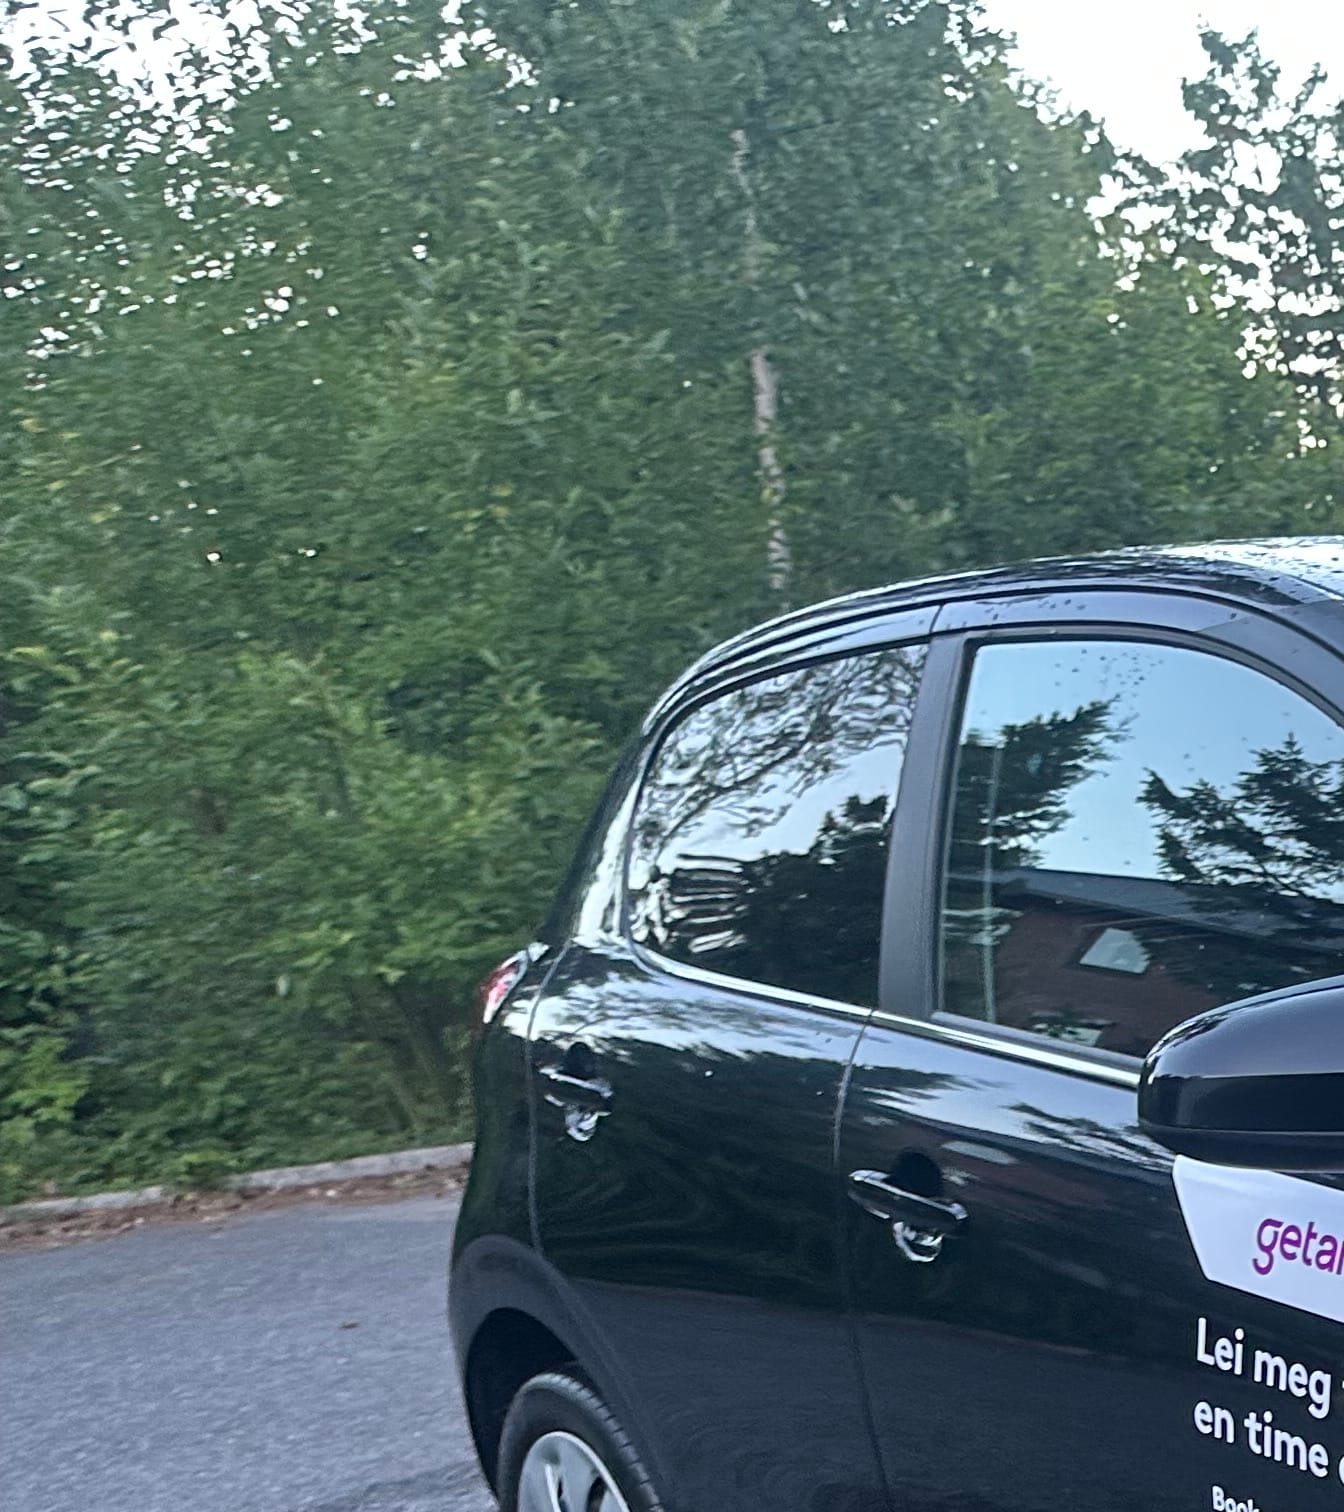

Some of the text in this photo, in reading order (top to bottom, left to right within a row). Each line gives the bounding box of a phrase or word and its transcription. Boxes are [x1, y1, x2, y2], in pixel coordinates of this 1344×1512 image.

[1196, 1317, 1244, 1375] Lei
[1253, 1349, 1332, 1419] meg
[1193, 1401, 1235, 1444] en
[1243, 1411, 1329, 1478] time
